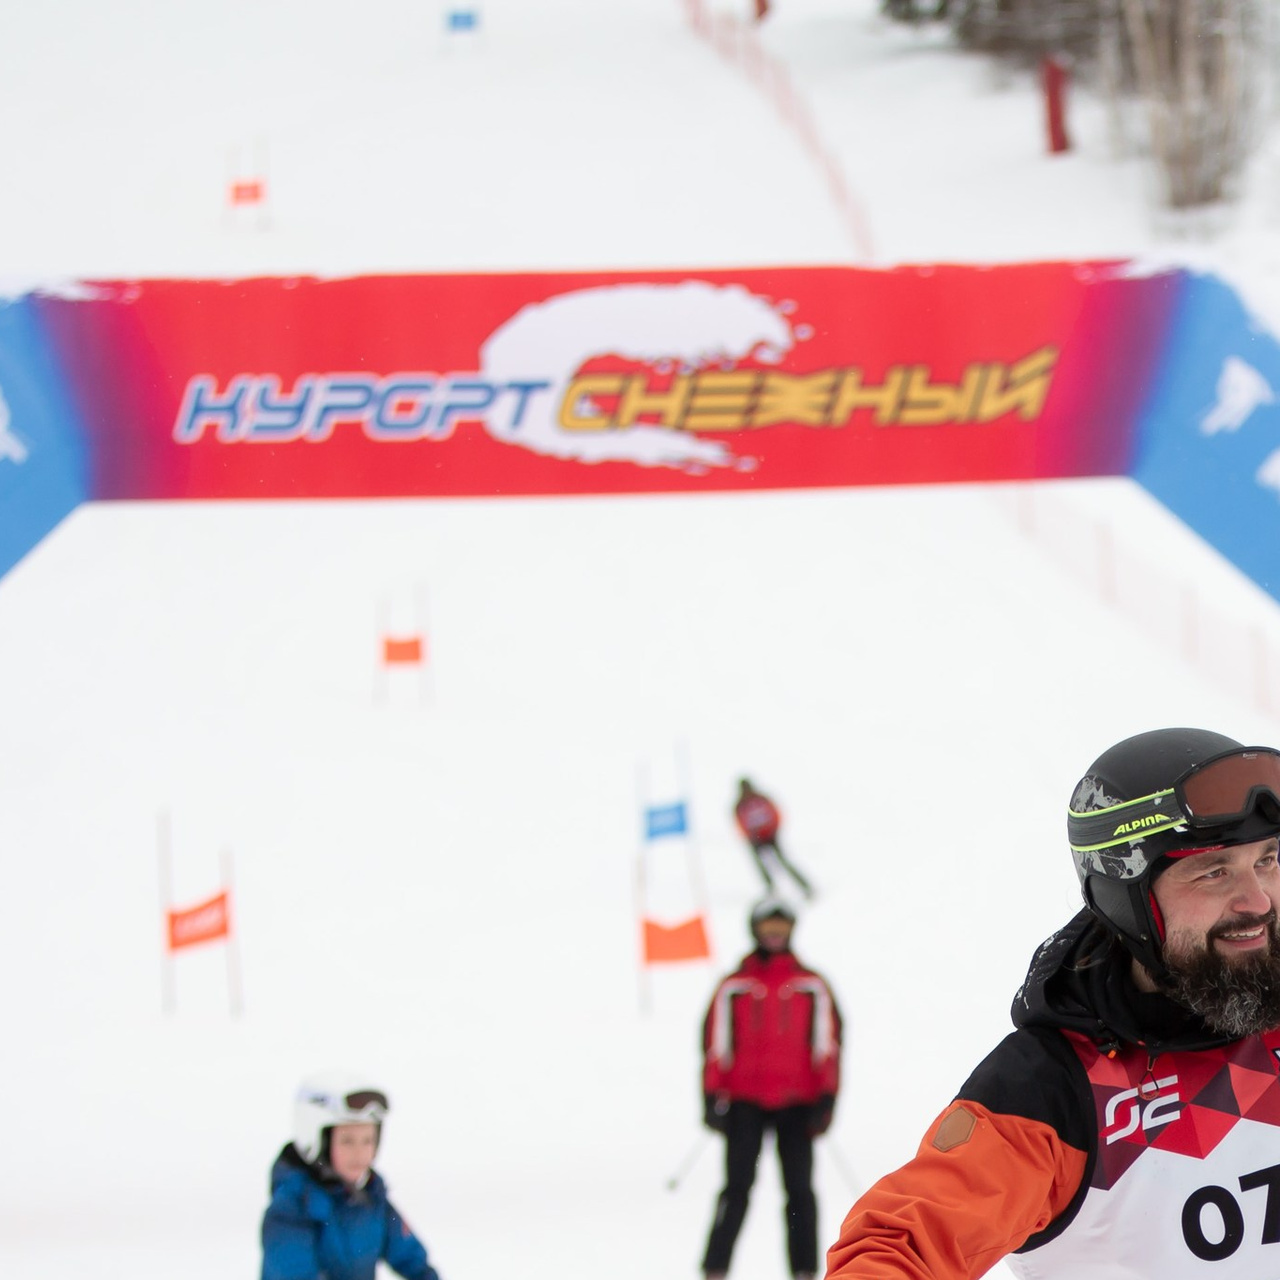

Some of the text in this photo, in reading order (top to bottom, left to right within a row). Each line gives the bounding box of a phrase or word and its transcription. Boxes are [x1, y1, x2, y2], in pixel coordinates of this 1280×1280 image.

[176, 343, 1059, 440] КУРОРТ СНЕЖНЫЙ
[1113, 813, 1171, 836] ALPINA
